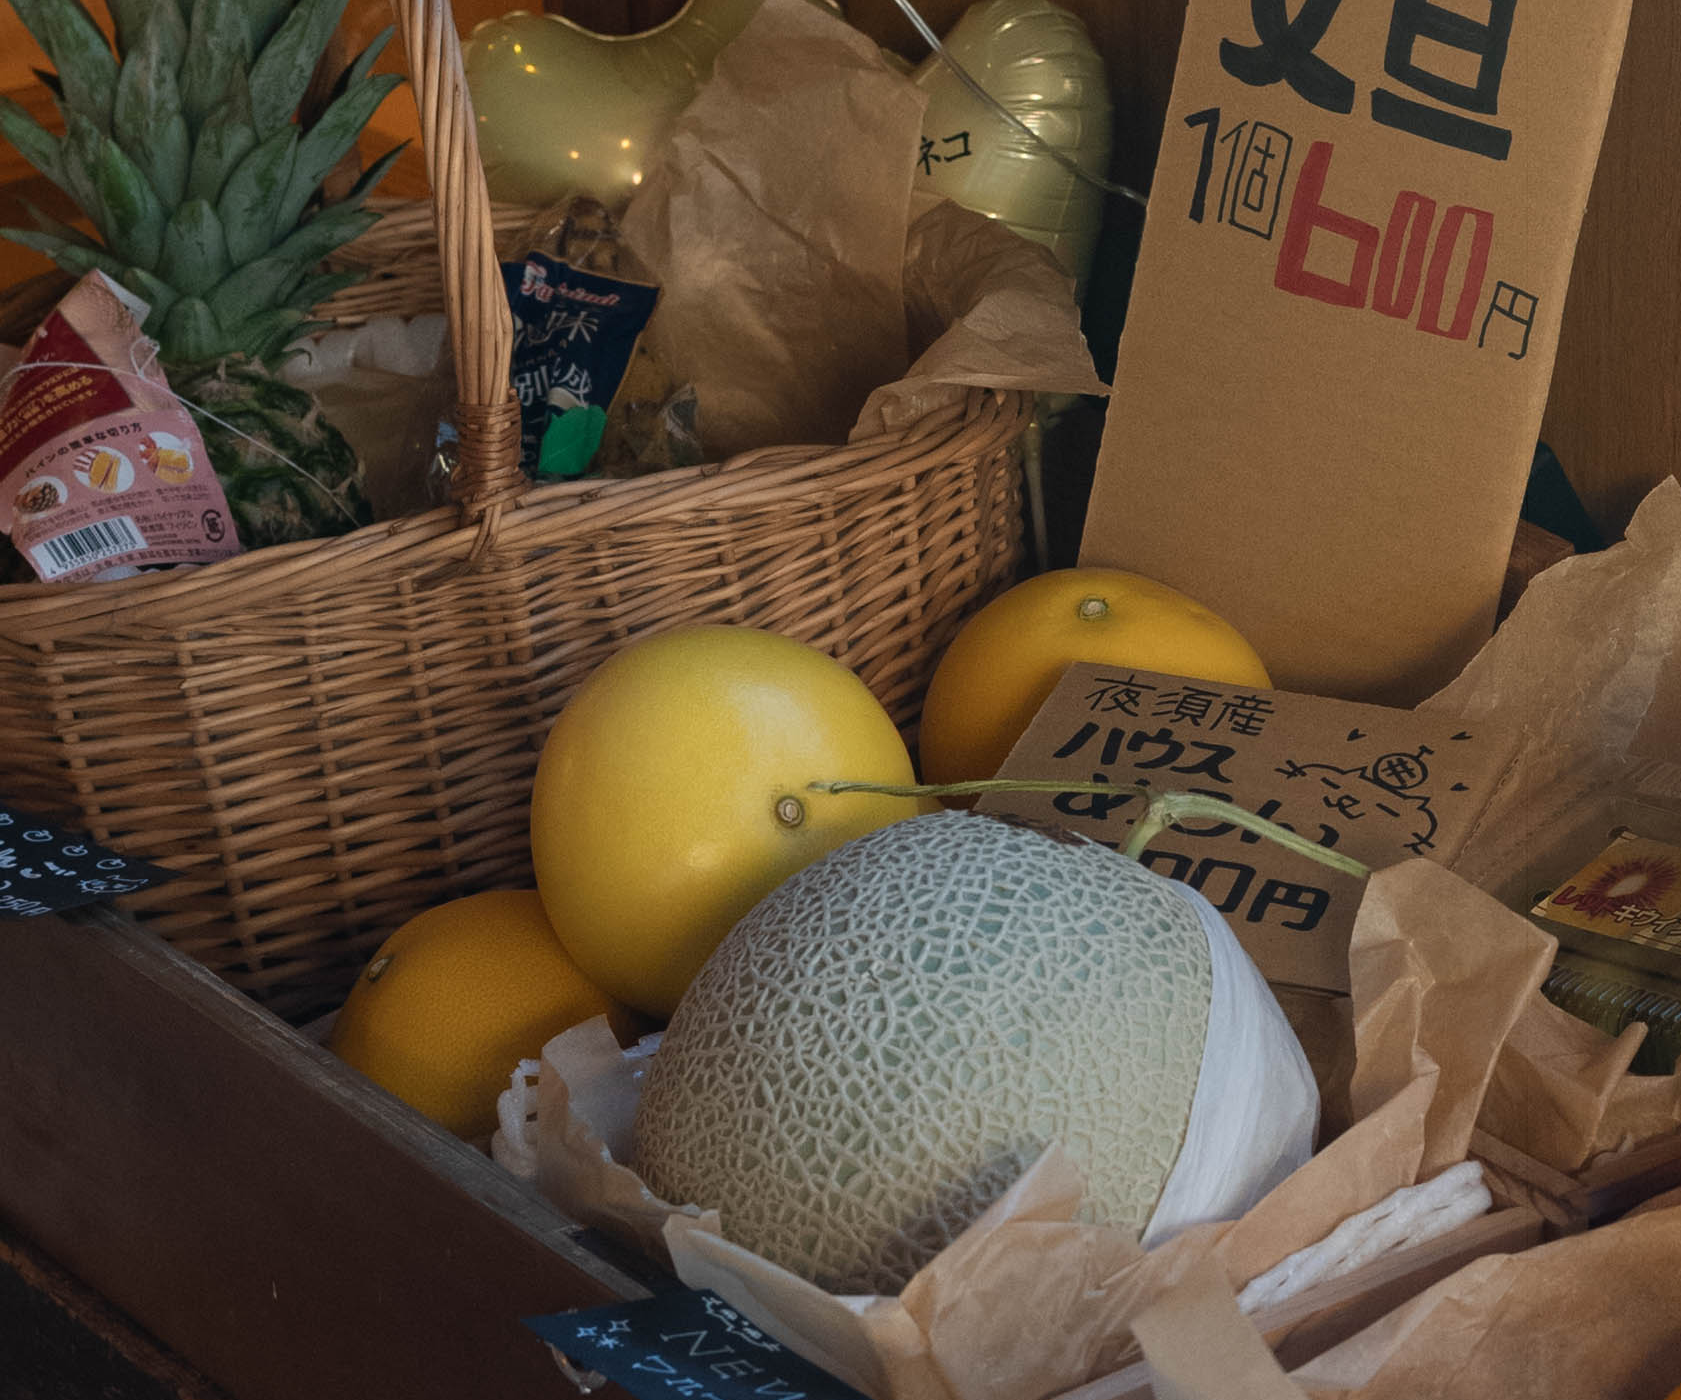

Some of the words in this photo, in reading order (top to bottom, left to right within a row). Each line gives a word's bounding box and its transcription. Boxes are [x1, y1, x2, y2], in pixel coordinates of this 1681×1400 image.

[1084, 674, 1276, 737] 夜須産
[1052, 720, 1238, 785] ハウス
